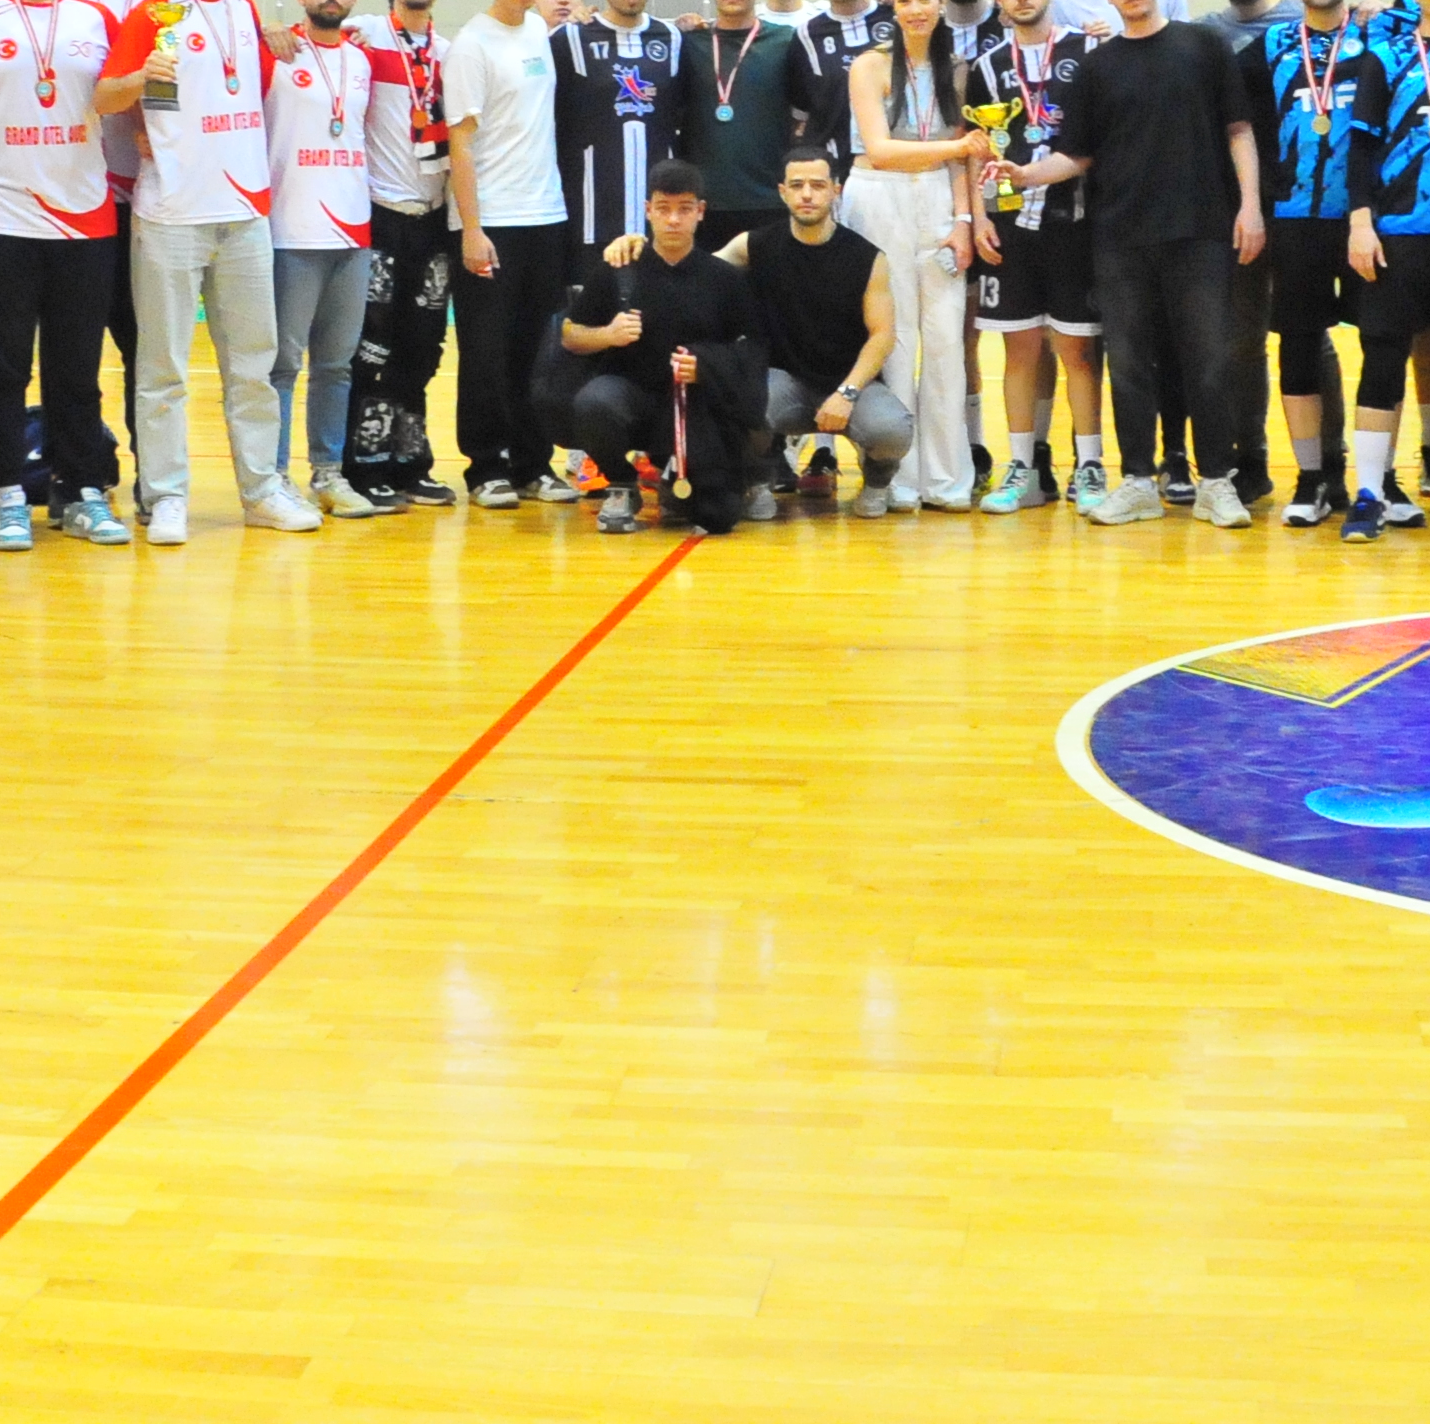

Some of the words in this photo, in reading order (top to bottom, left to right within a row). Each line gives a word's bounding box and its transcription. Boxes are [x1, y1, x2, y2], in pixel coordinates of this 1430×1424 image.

[589, 40, 610, 60] 17
[823, 36, 837, 54] 8
[5, 126, 39, 146] GRAND
[44, 125, 66, 145] OTEL
[298, 149, 330, 166] GRAND
[979, 275, 1000, 308] 13
